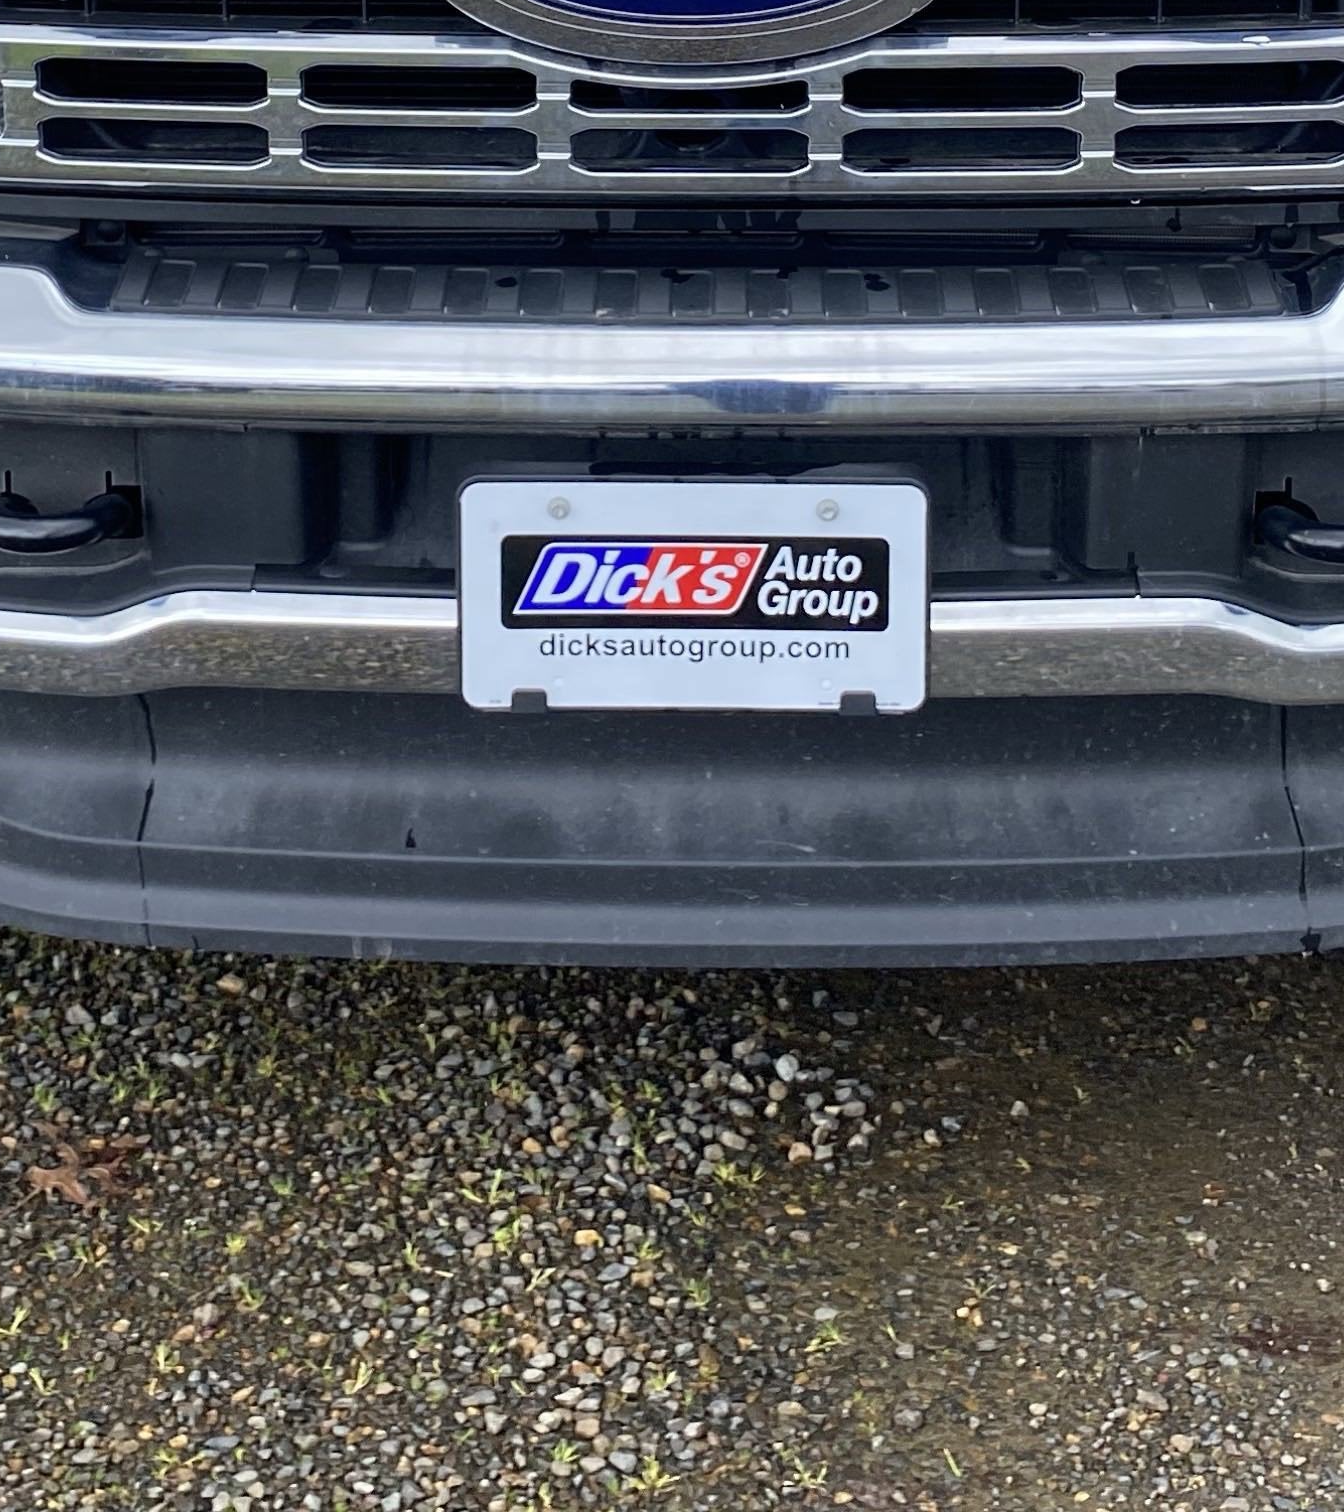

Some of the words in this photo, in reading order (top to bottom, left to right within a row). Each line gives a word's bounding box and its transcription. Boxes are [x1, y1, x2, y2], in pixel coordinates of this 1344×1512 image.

[764, 545, 863, 583] Auto
[757, 581, 879, 625] Group
[539, 633, 851, 663] dicksautogroup.com
